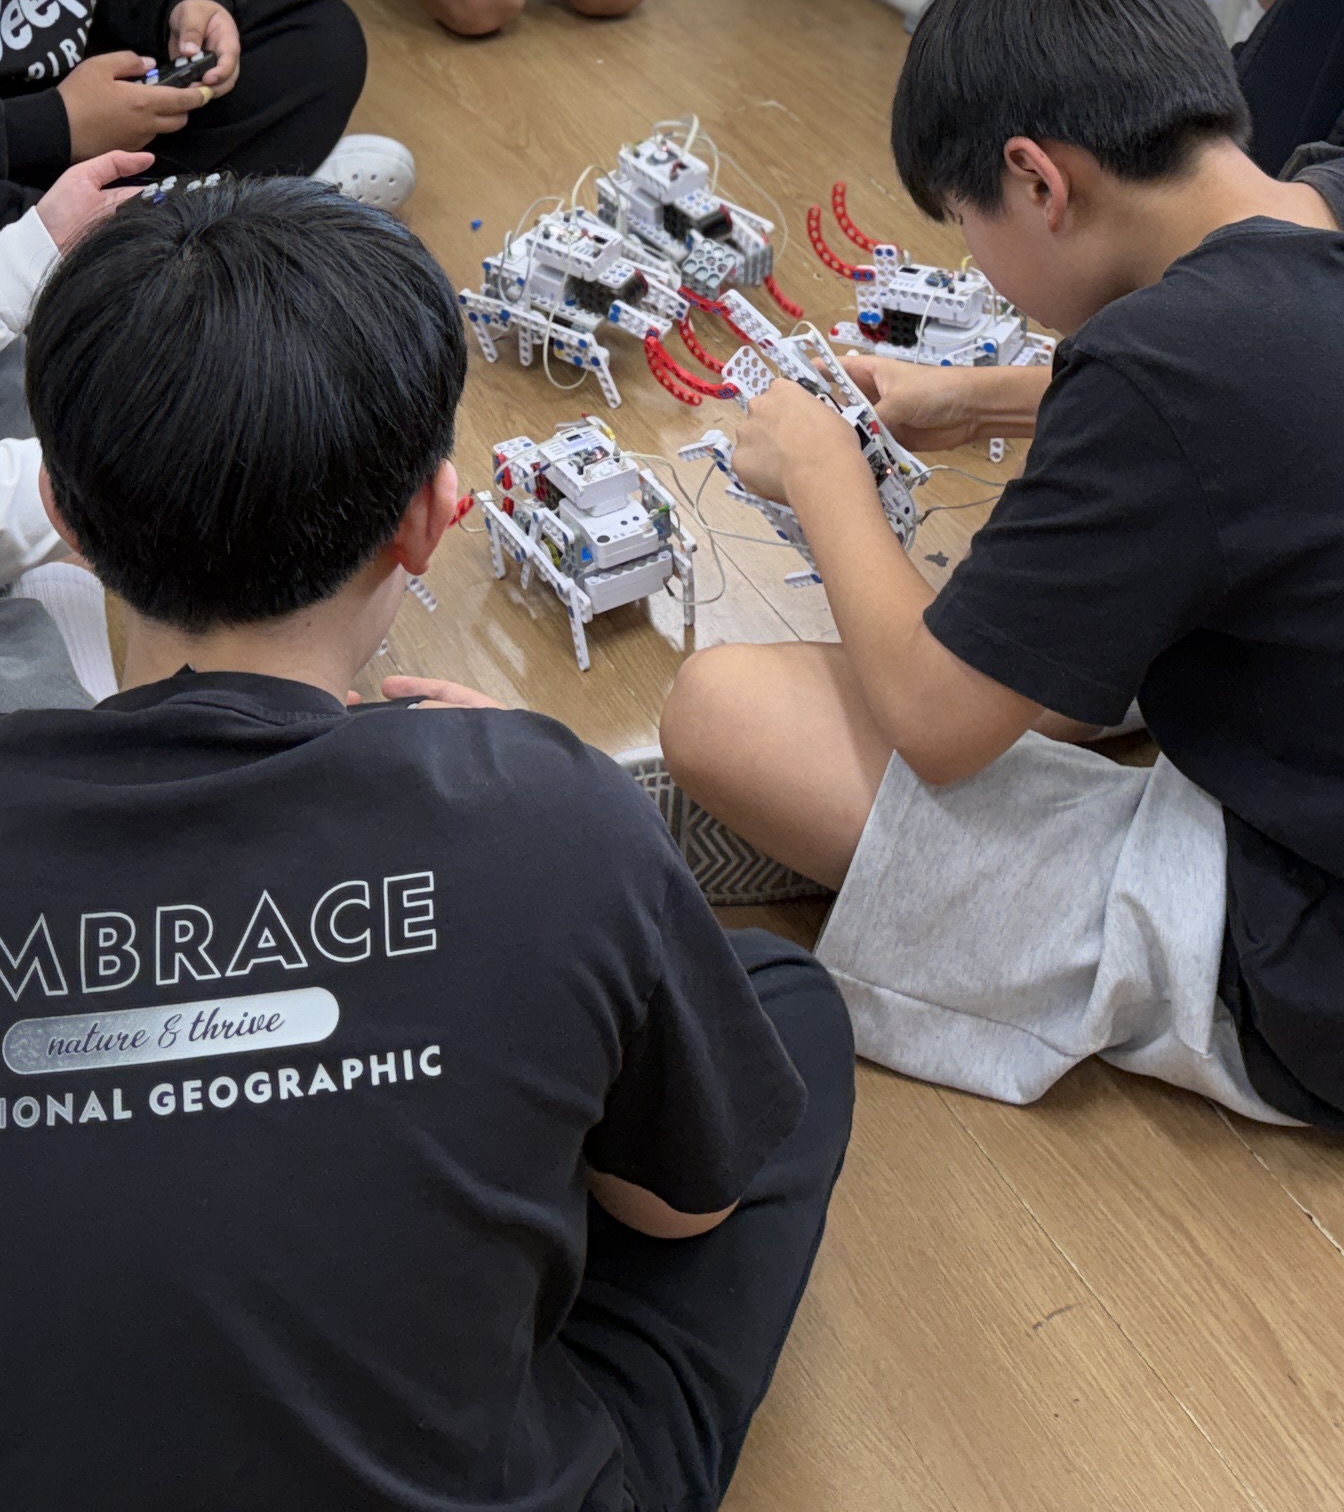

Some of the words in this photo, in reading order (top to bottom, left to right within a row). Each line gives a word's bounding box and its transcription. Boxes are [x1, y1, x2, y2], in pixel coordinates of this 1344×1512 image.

[47, 1020, 150, 1057] nature
[157, 1014, 182, 1049] &
[188, 1007, 285, 1042] thrive
[148, 1045, 442, 1116] GEOGRAPHIC
